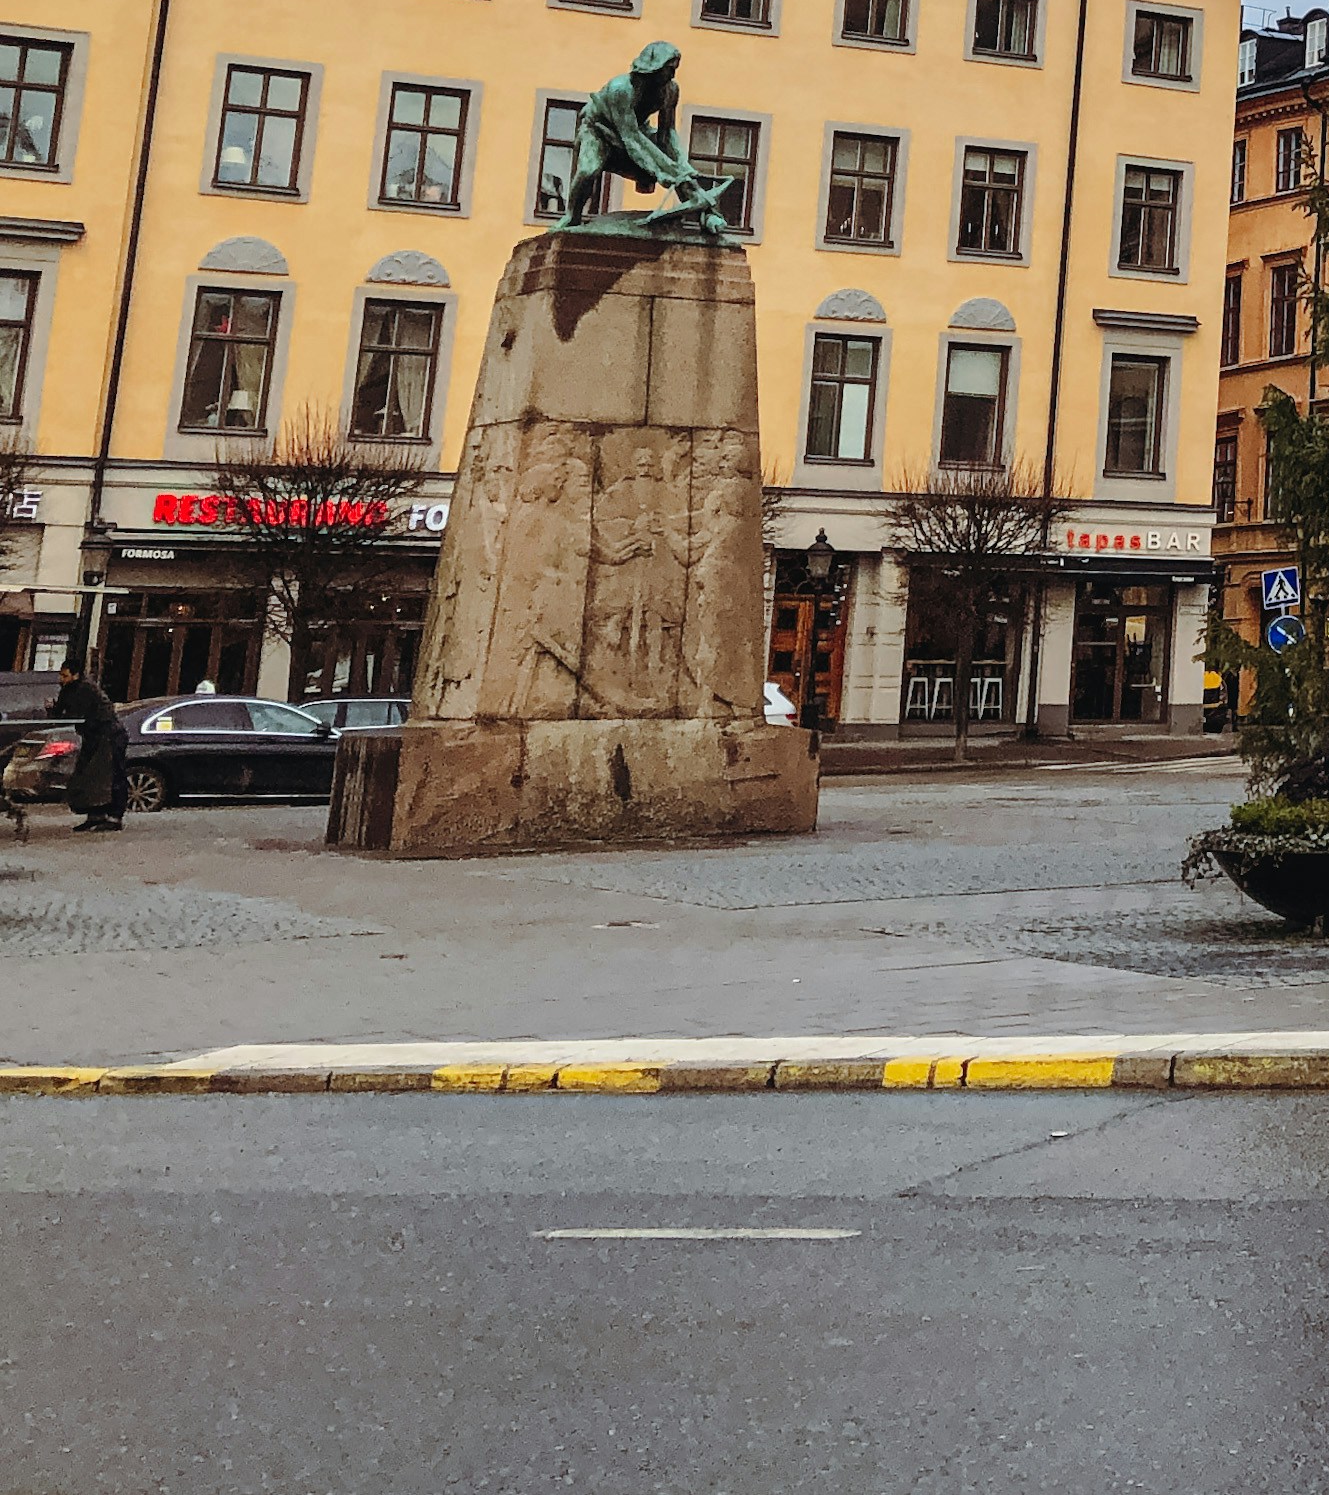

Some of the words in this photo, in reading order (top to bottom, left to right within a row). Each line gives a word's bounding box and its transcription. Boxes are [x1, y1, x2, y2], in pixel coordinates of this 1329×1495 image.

[152, 493, 388, 528] RESTAURANG
[407, 504, 450, 533] FO
[121, 548, 175, 560] FORMOSA
